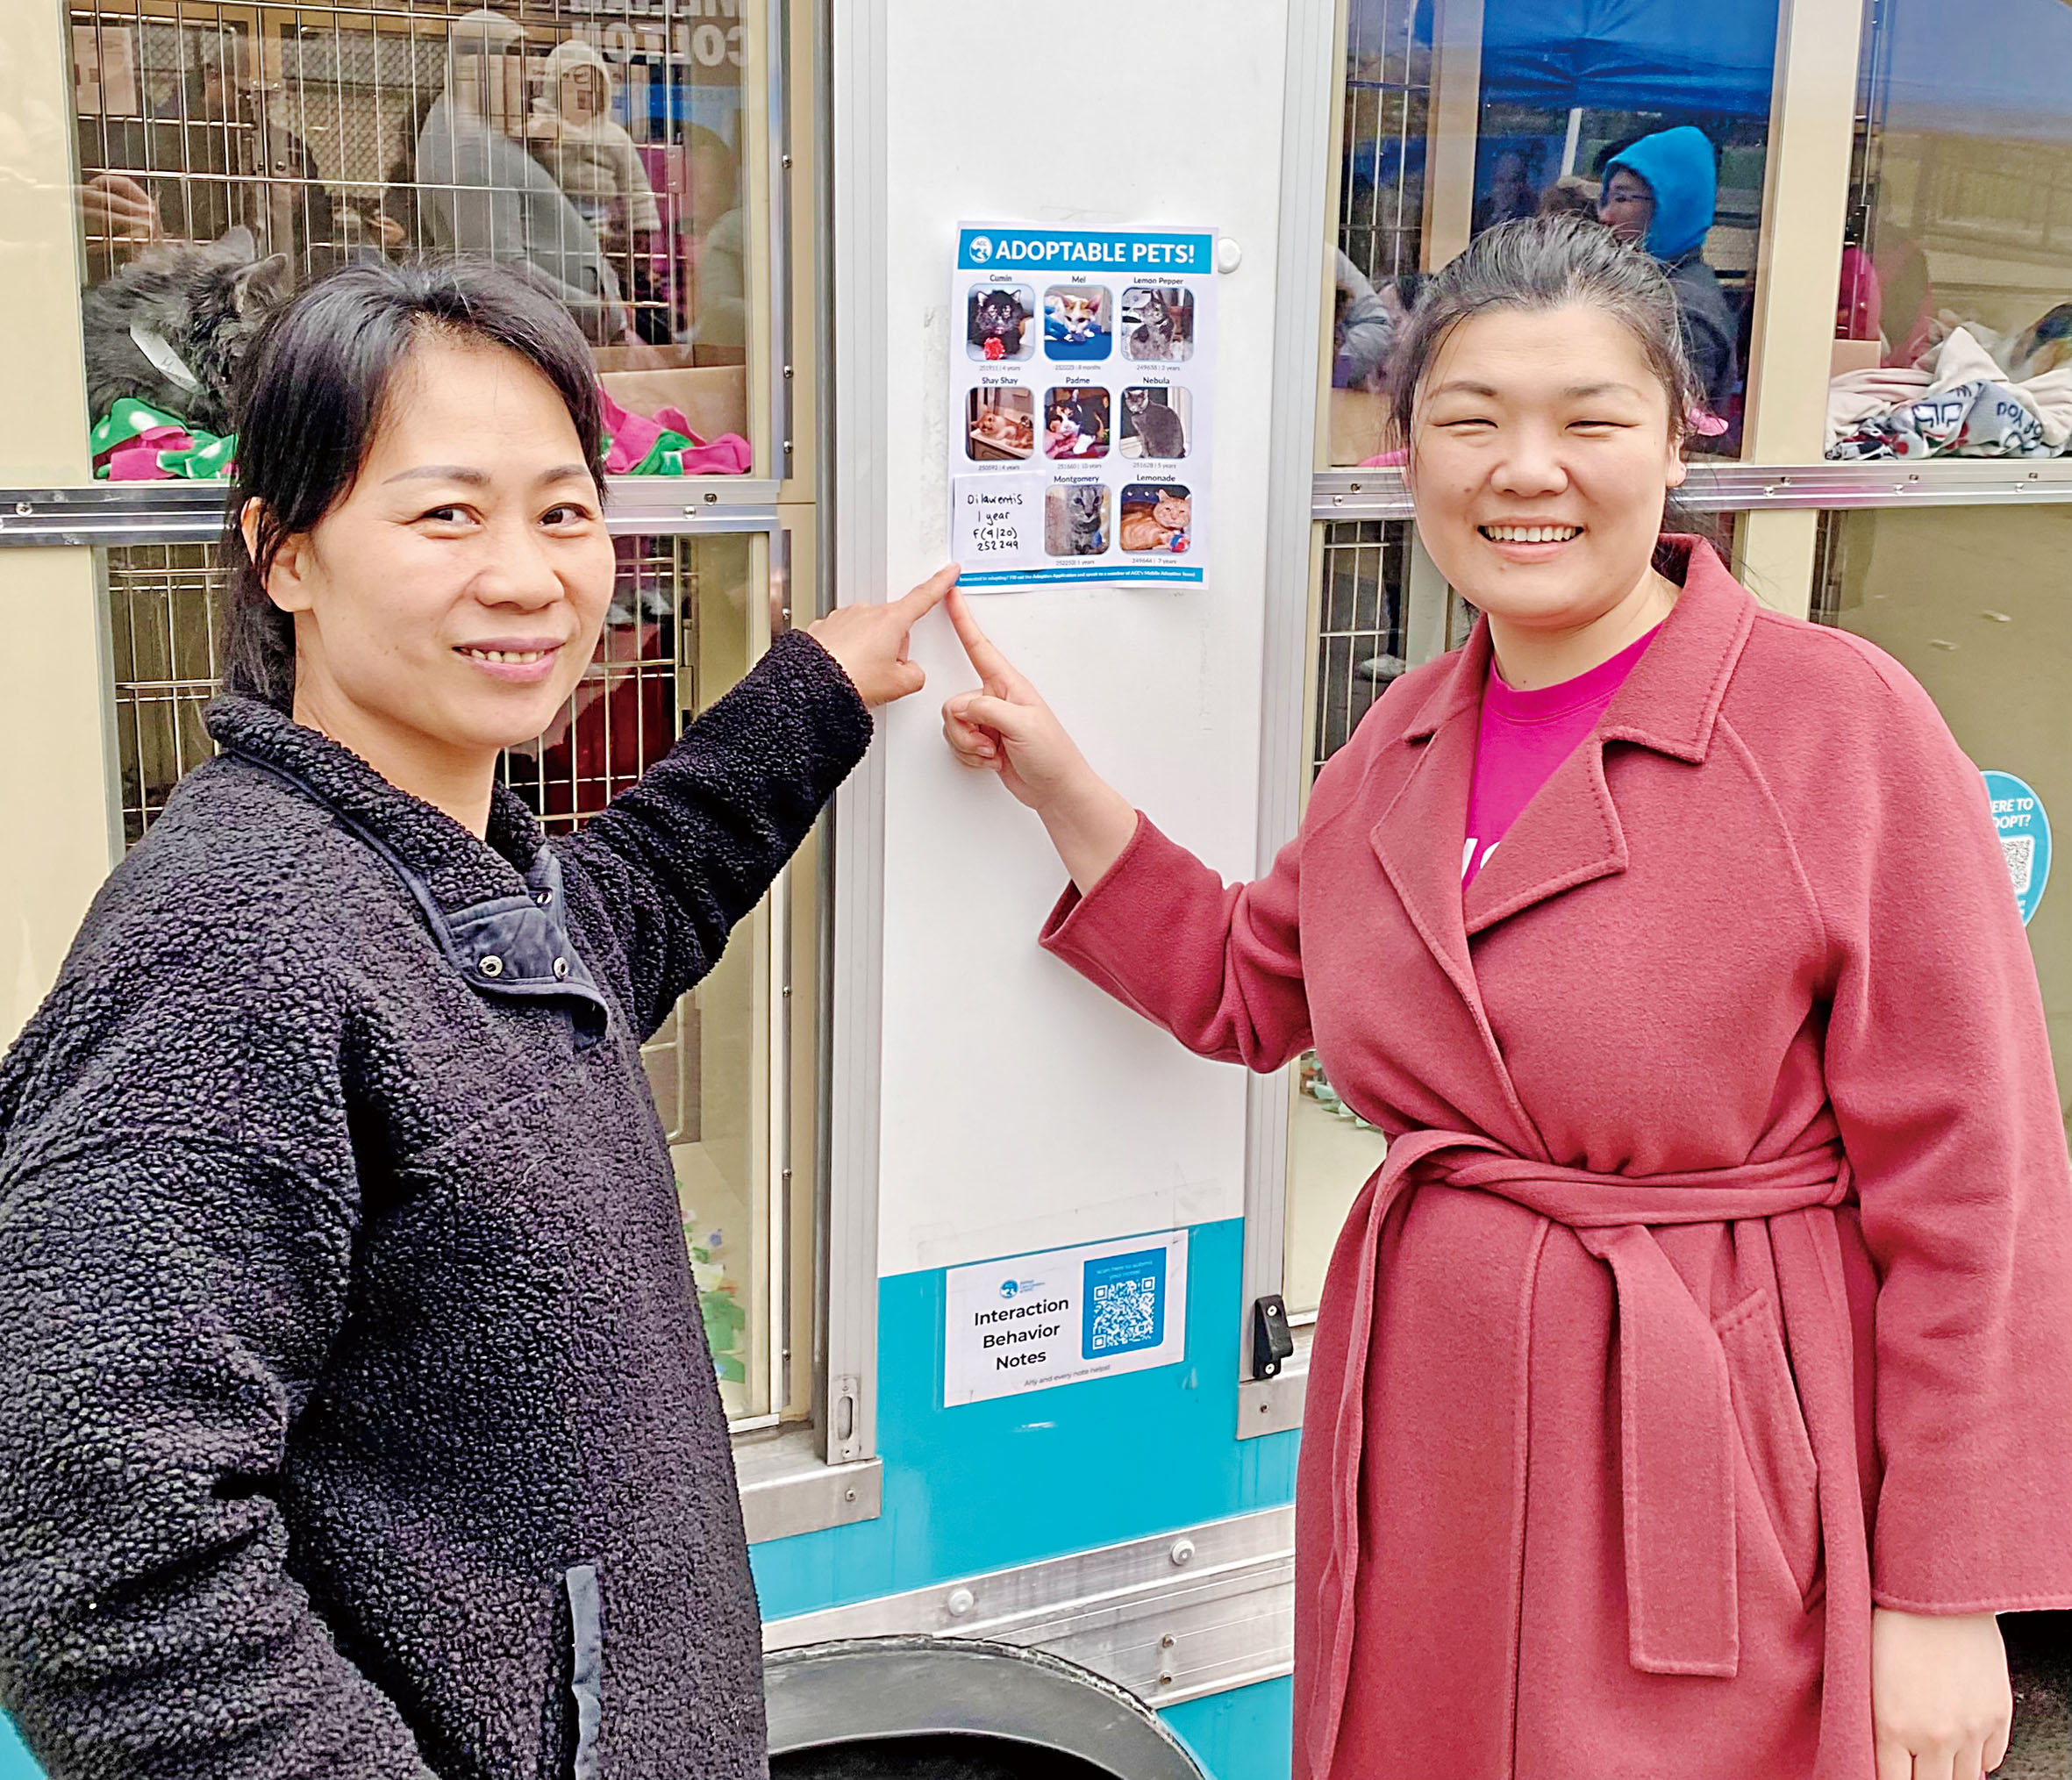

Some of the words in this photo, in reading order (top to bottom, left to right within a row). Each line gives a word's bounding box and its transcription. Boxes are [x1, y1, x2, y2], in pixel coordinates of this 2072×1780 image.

[996, 239, 1126, 262] ADOPTABLE
[1133, 243, 1195, 263] PETS!
[990, 274, 1012, 282] Cumin
[1159, 277, 1183, 286] Pepper
[982, 376, 998, 385] Shay
[1000, 376, 1018, 385] Shay
[1054, 474, 1100, 484] Montgomery
[986, 511, 1011, 526] year
[1990, 799, 2015, 813] ERE
[2017, 797, 2034, 811] TO
[1994, 814, 2031, 829] DOPT?
[975, 1297, 1068, 1326] Interaction
[982, 1323, 1061, 1348] Behavior
[996, 1350, 1047, 1370] Notes
